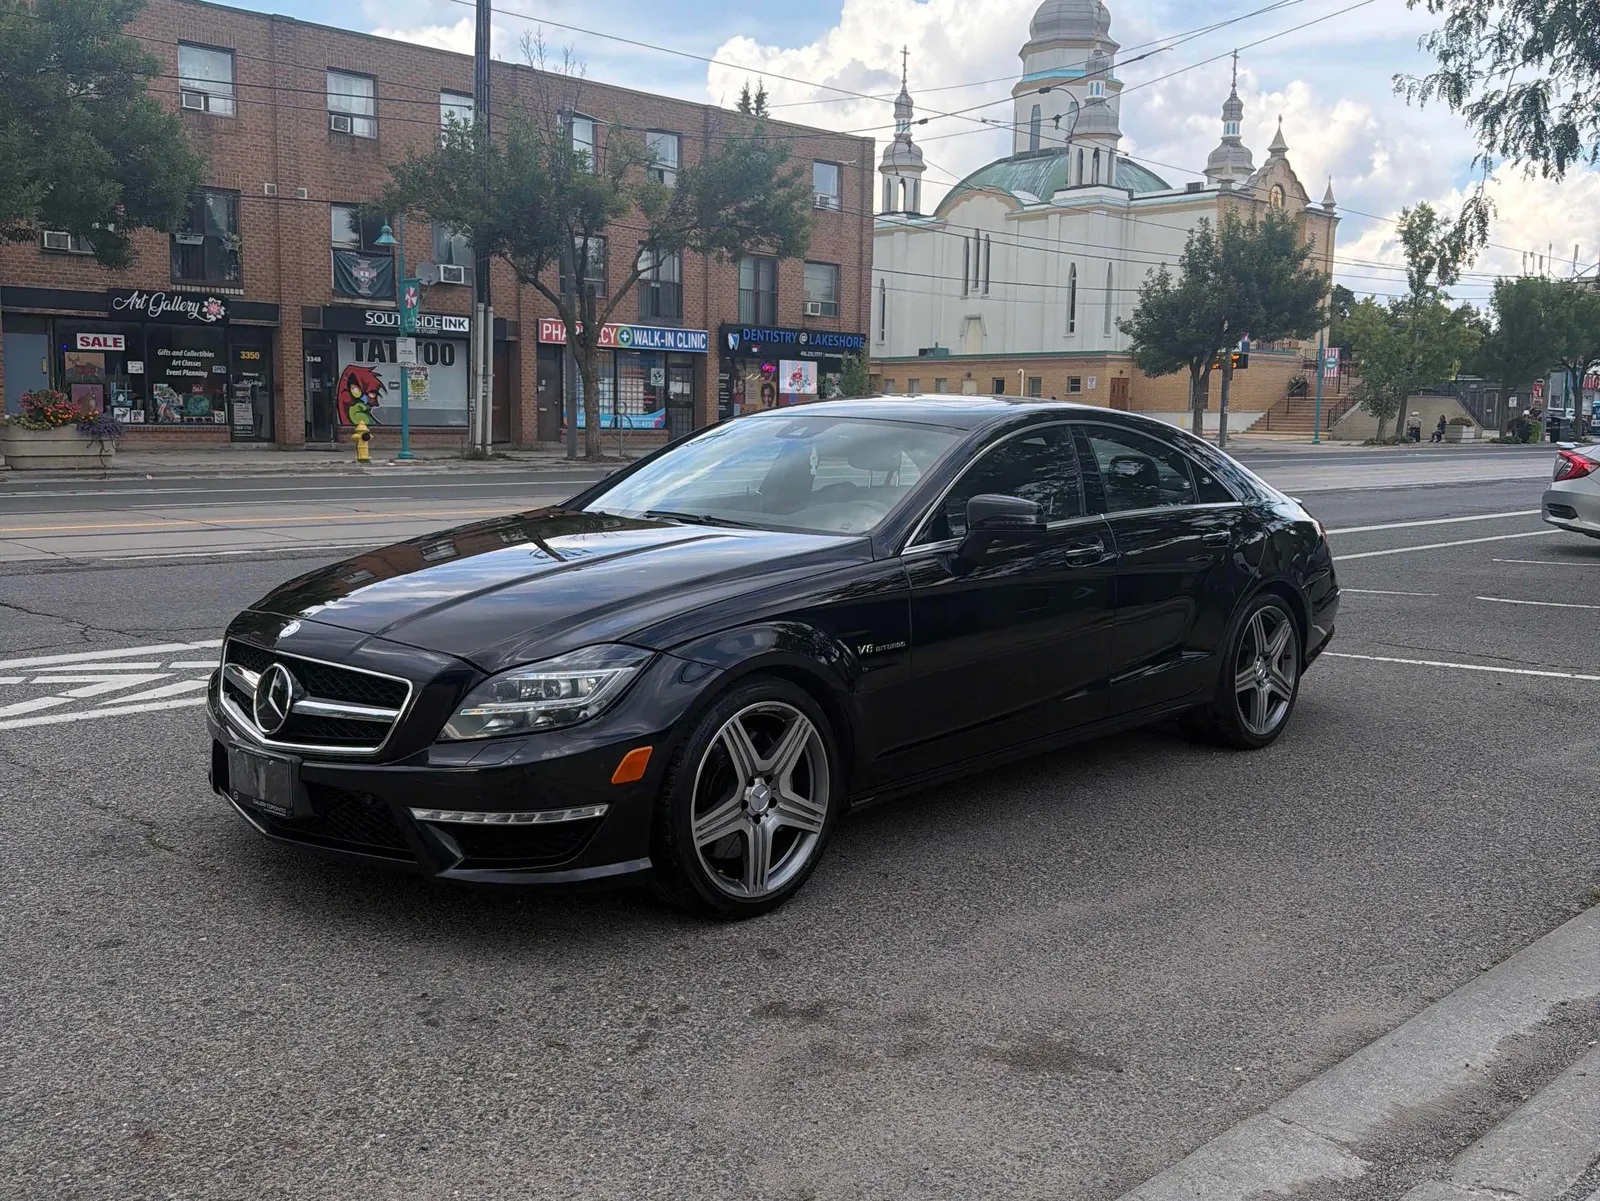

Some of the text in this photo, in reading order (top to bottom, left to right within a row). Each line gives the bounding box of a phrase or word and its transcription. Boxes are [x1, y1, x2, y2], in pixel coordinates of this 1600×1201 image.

[113, 290, 210, 322] Art Gallery
[365, 312, 442, 328] SOUTSIDE
[444, 317, 467, 330] INK
[79, 336, 123, 348] SALE
[633, 329, 674, 347] WALK-IN
[677, 332, 706, 349] CLINIC
[743, 328, 864, 348] DENTISTRY @ LAKESHORE
[157, 348, 171, 356] Gifts
[183, 350, 215, 358] Collectibles
[240, 351, 260, 360] 3350
[182, 369, 208, 378] Planning
[875, 641, 906, 652] BITURBO
